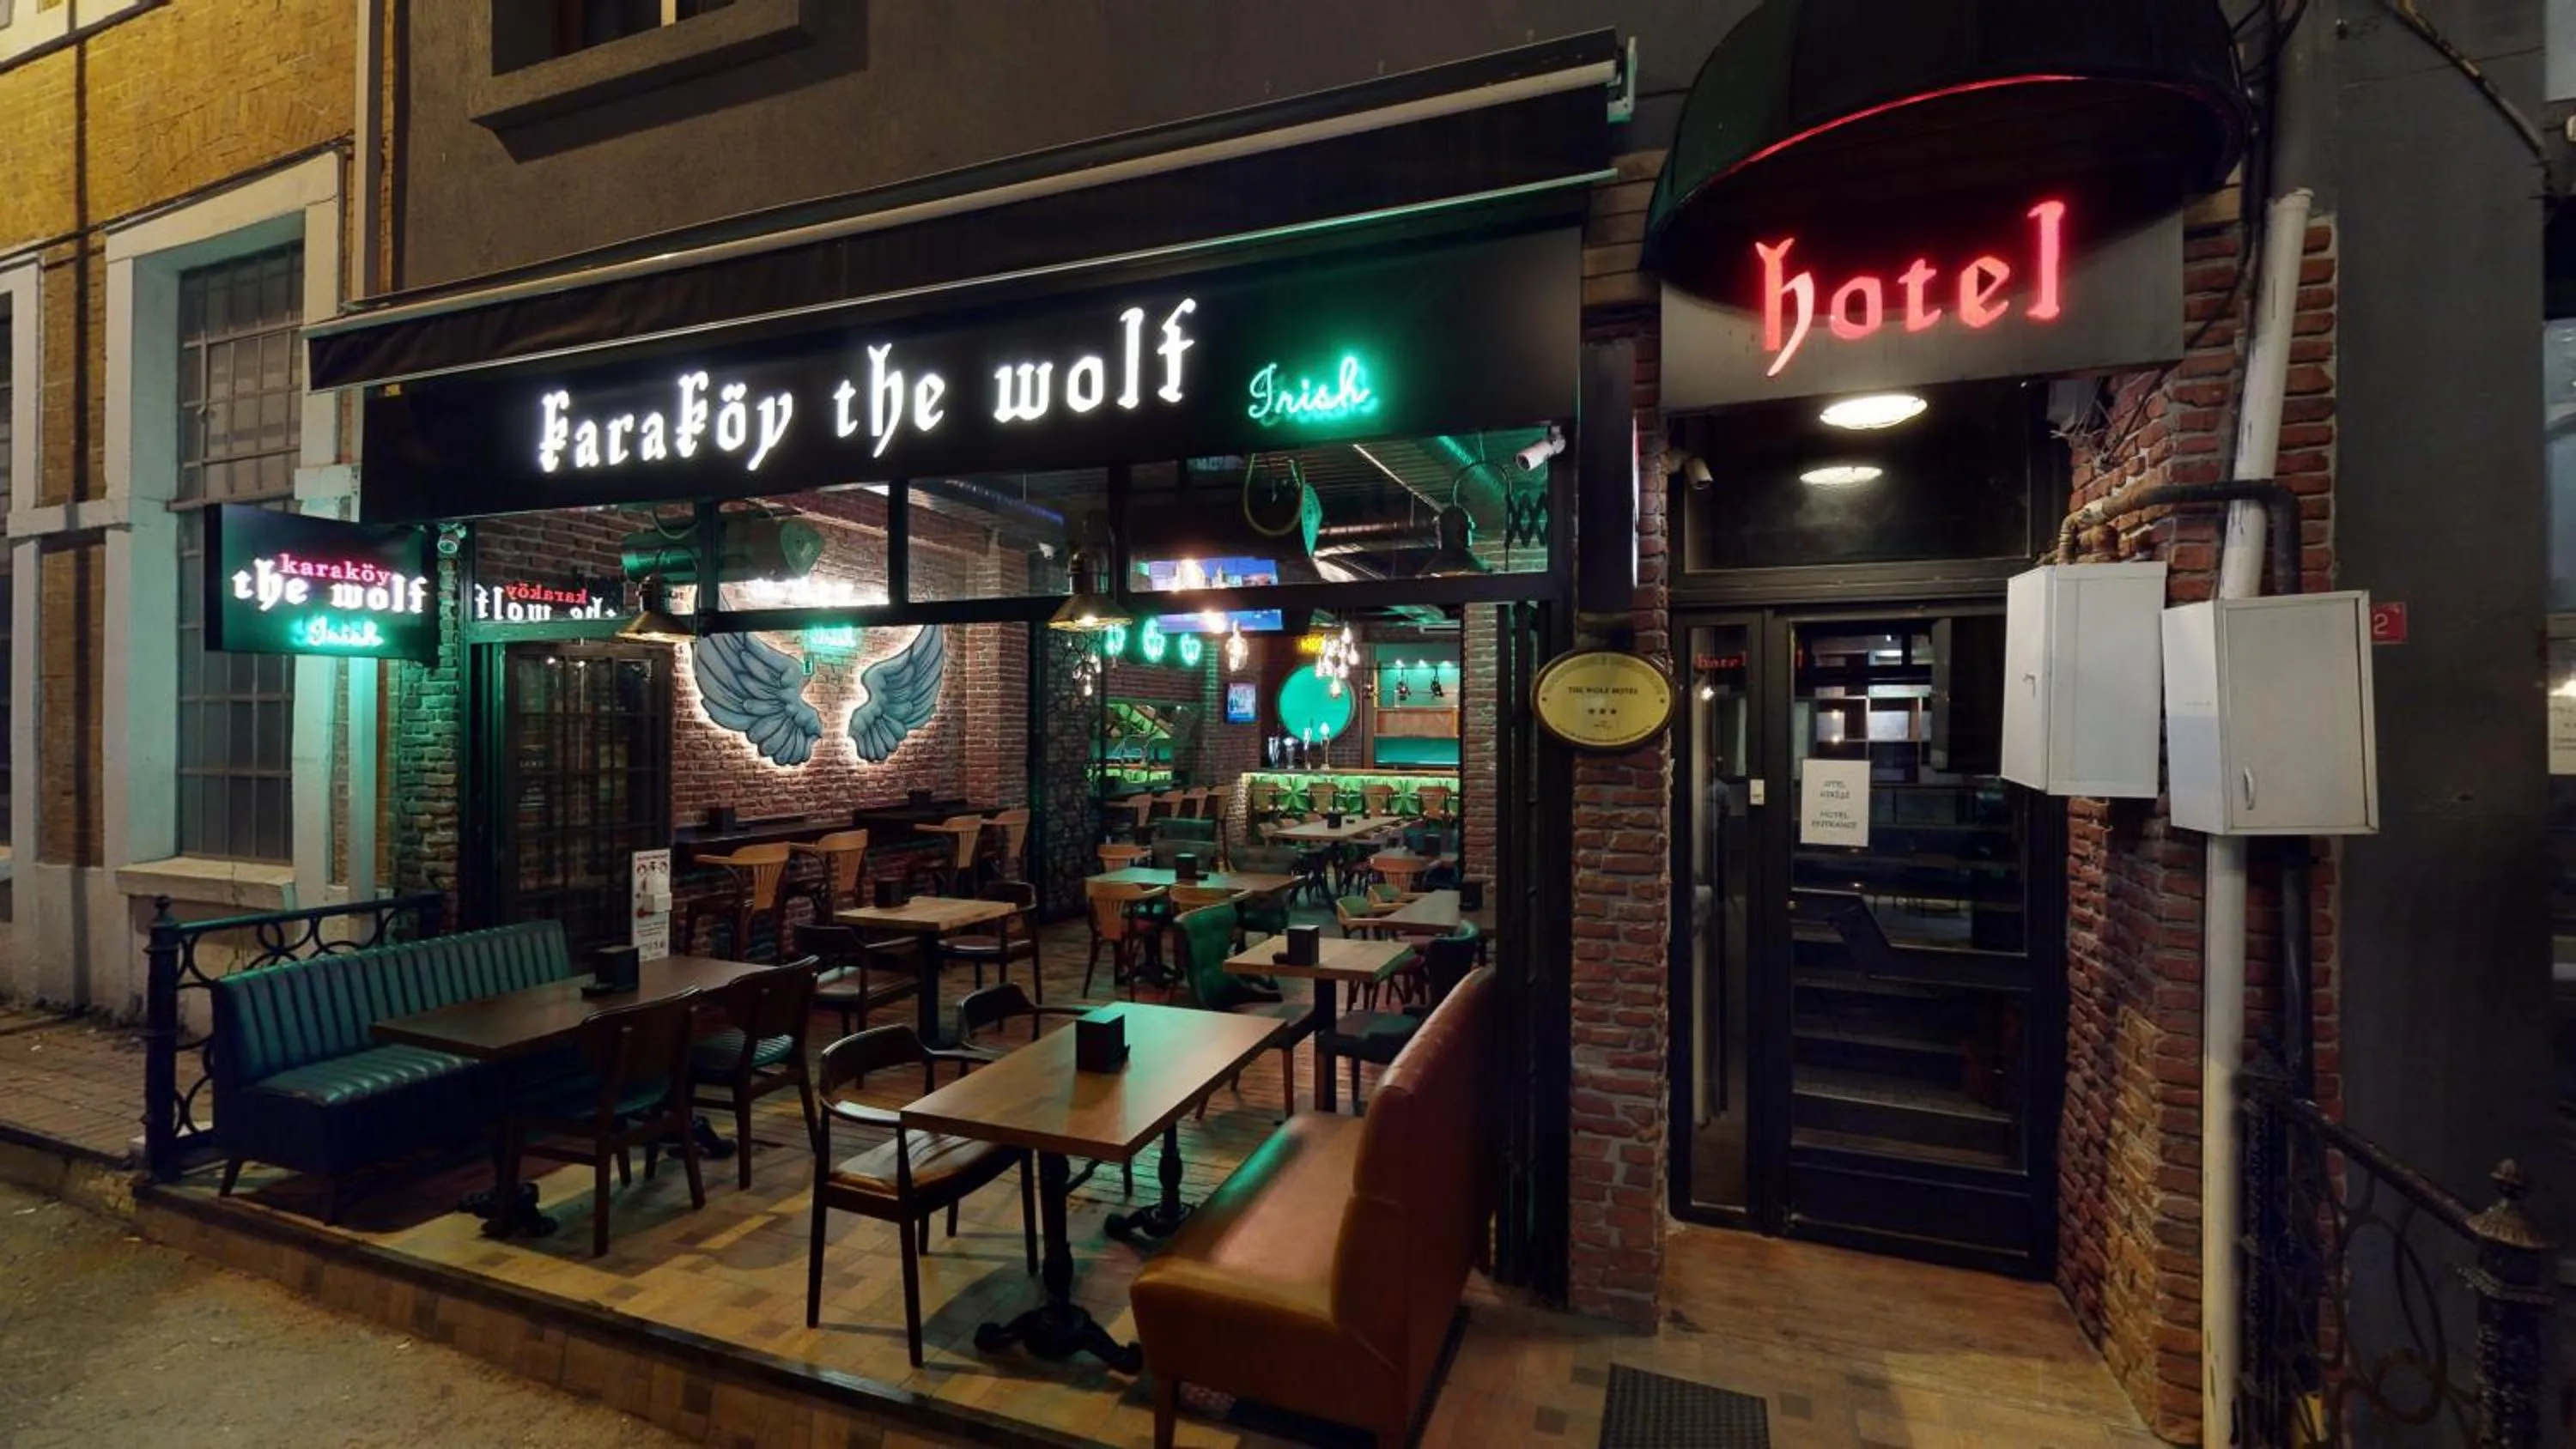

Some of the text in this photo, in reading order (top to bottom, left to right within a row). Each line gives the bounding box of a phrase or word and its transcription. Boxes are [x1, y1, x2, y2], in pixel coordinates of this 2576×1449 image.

[1755, 200, 2065, 376] hotel
[538, 298, 1196, 472] karaköy the wolf
[1248, 355, 1370, 419] Irish
[232, 558, 428, 614] the wolf
[279, 553, 391, 585] karaköy
[307, 615, 385, 646] Irish
[2374, 613, 2388, 634] 2
